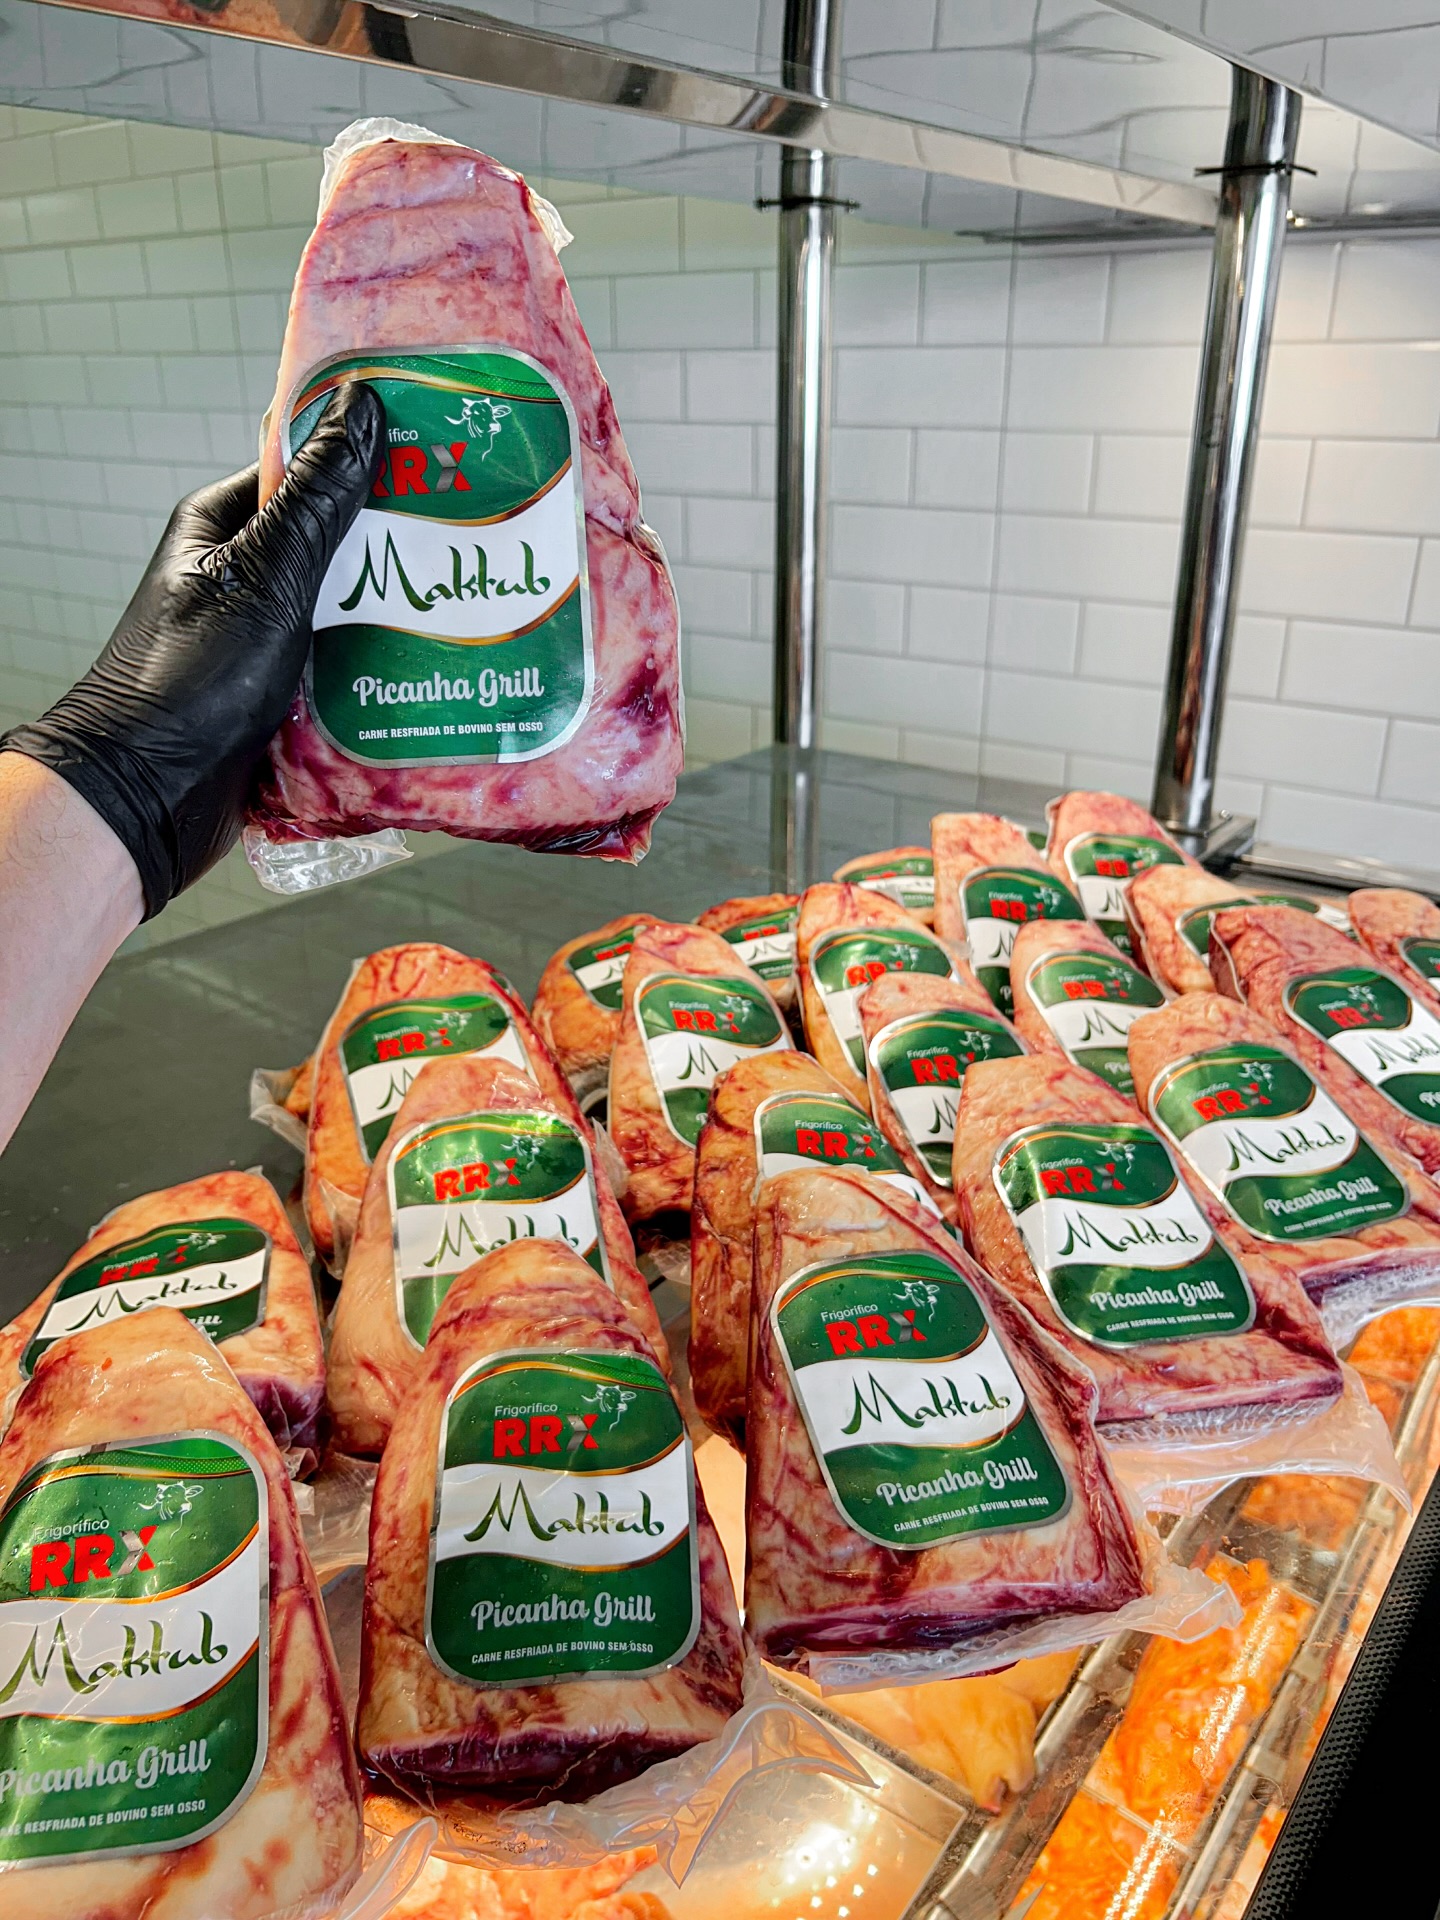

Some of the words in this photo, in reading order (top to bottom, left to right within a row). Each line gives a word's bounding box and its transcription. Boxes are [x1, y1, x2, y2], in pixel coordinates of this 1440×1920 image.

[337, 527, 551, 612] Maktub
[352, 671, 475, 707] Picanha
[478, 666, 545, 708] Grill
[358, 729, 389, 740] CARNE
[390, 725, 441, 738] RESFRIADA
[443, 725, 456, 735] DE
[458, 723, 493, 734] BOVINO
[495, 721, 516, 733] SEM
[518, 721, 544, 732] OSSO
[672, 1009, 741, 1033] RRX
[376, 1028, 453, 1062] RRX
[796, 1129, 877, 1158] RRX
[1223, 1121, 1346, 1171] Maktub
[433, 1158, 521, 1201] RRX
[1039, 1162, 1127, 1196] RRX
[1264, 1187, 1341, 1217] Picanha
[1336, 1176, 1380, 1201] Grill
[1056, 1209, 1199, 1256] Maktub
[820, 1302, 879, 1323] Frigorífico
[1089, 1286, 1179, 1311] Picanha
[1177, 1280, 1225, 1307] Grill
[824, 1309, 927, 1356] RRX
[494, 1402, 558, 1417] Frigorífico
[840, 1370, 1011, 1435] Maktub
[493, 1413, 599, 1458] RRX
[876, 1468, 984, 1506] Picanha
[983, 1456, 1038, 1490] Grill
[463, 1479, 665, 1542] Maktub
[893, 1519, 922, 1532] CARNE
[922, 1508, 968, 1526] RESFRIADA
[968, 1504, 980, 1514] DE
[980, 1501, 1010, 1512] BOVINO
[1010, 1498, 1028, 1508] SEM
[1029, 1496, 1049, 1506] OSSO
[29, 1525, 158, 1592] RRX
[470, 1593, 590, 1631] Picanha
[593, 1592, 656, 1627] Grill
[0, 1611, 228, 1702] Maktub
[472, 1652, 502, 1664] CARNE
[504, 1644, 554, 1660] RESFRIADA
[556, 1642, 568, 1652] DE
[571, 1640, 605, 1651] BOVINO
[608, 1641, 627, 1651] SEM
[630, 1643, 654, 1653] OSSO
[0, 1756, 132, 1804] Picanha
[134, 1738, 212, 1790] Grill
[24, 1816, 86, 1834] RESFRIADA
[89, 1815, 103, 1827] DE
[106, 1806, 148, 1825] BOVINO
[150, 1803, 174, 1817] SEM
[177, 1799, 206, 1815] OSSO
